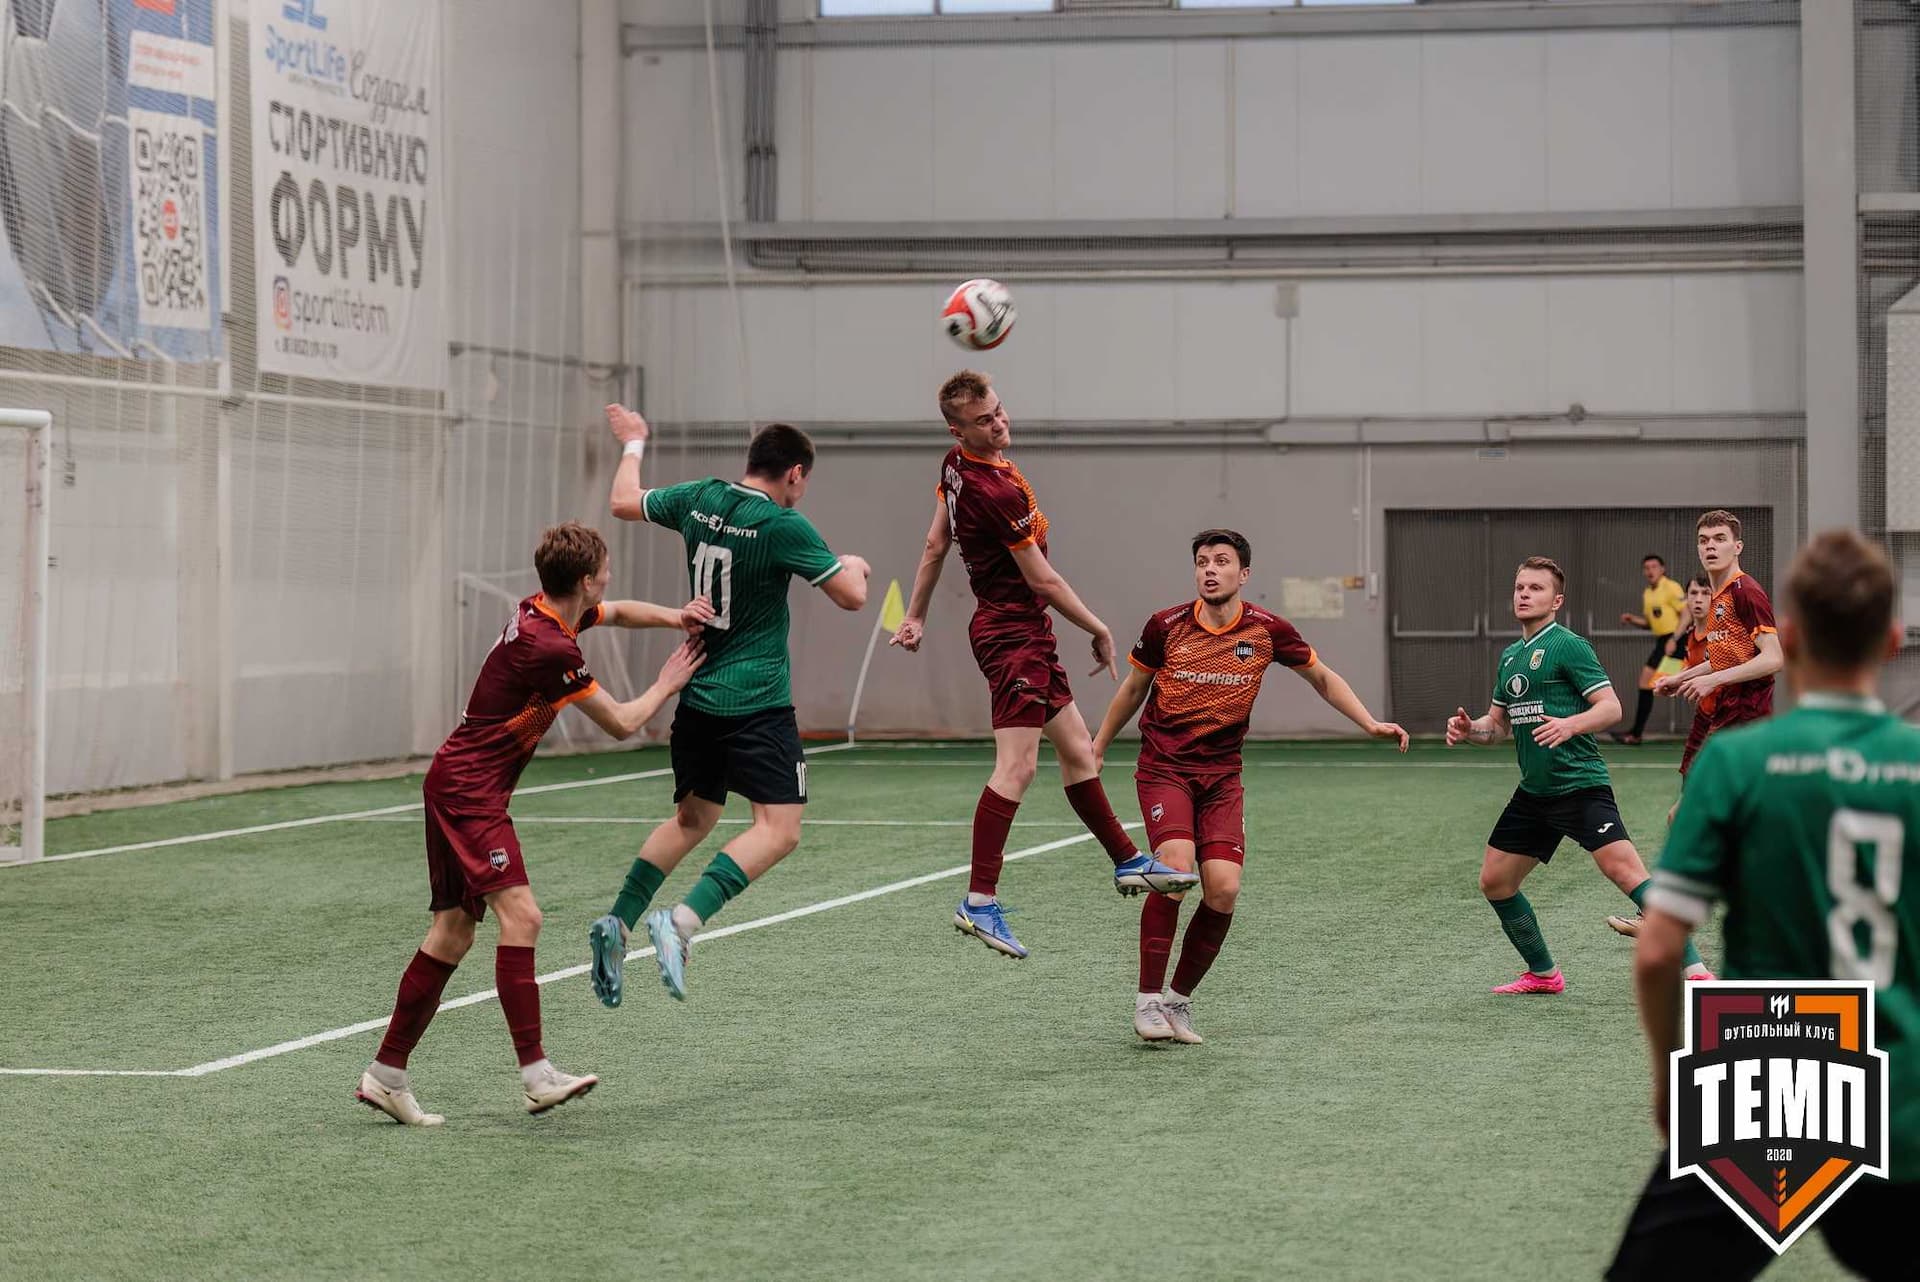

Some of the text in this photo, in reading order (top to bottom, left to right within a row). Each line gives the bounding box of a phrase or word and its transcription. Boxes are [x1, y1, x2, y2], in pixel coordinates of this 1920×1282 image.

[269, 100, 428, 186] СПОРТИВНУЮ
[270, 170, 427, 289] ФОРМУ
[692, 541, 732, 630] 10
[1826, 807, 1904, 990] 8
